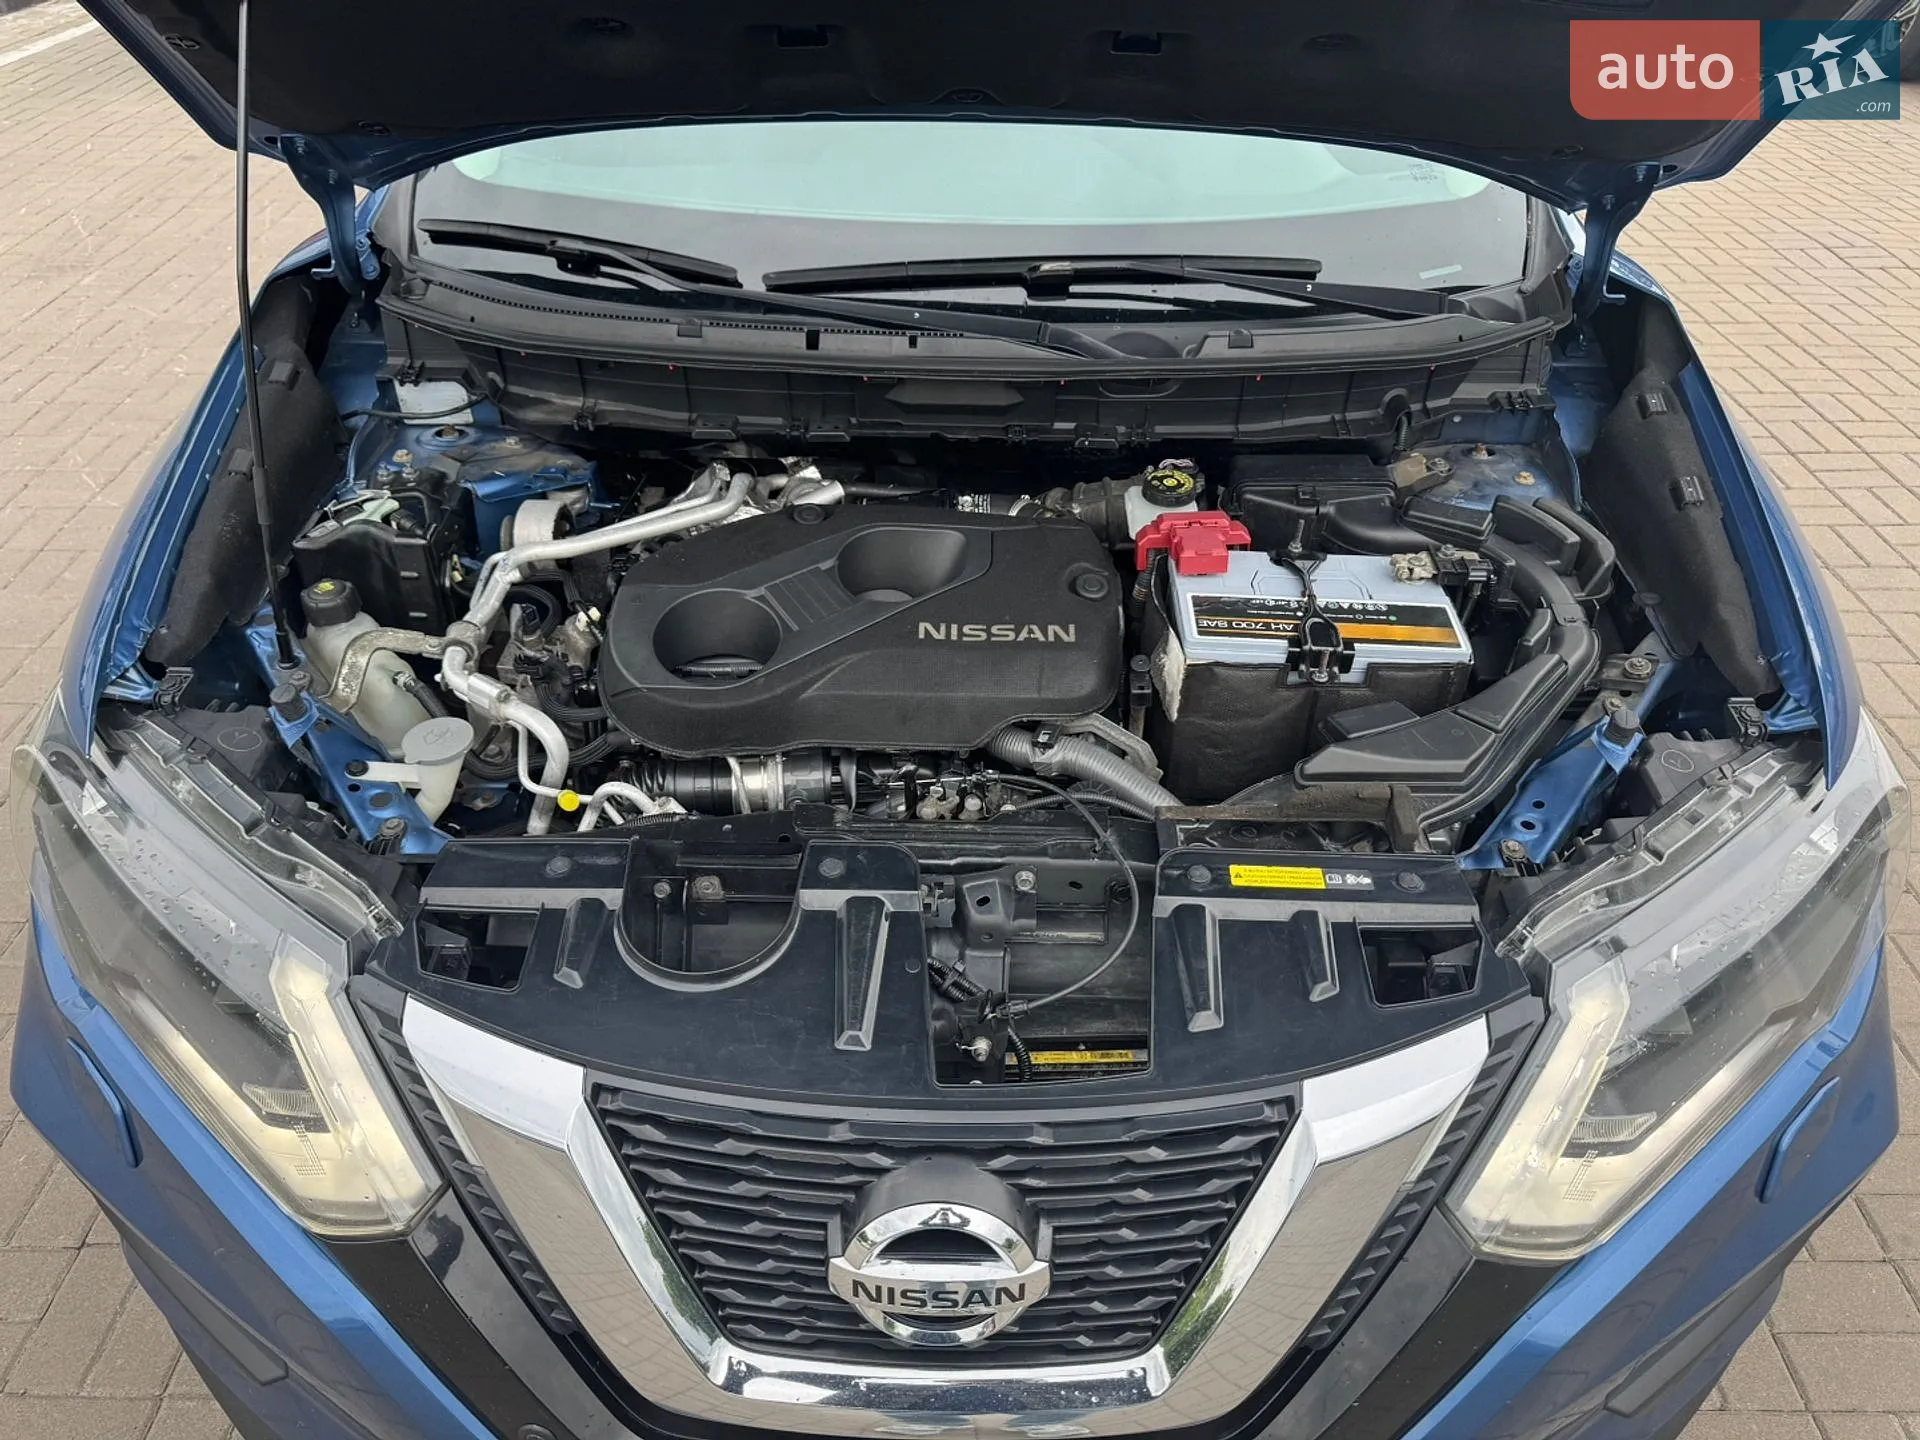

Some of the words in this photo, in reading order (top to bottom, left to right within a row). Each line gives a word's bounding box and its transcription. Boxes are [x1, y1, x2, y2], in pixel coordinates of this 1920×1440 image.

[917, 621, 1077, 643] NISSAN
[1232, 620, 1266, 630] 700
[851, 1278, 1027, 1310] NISSAN
